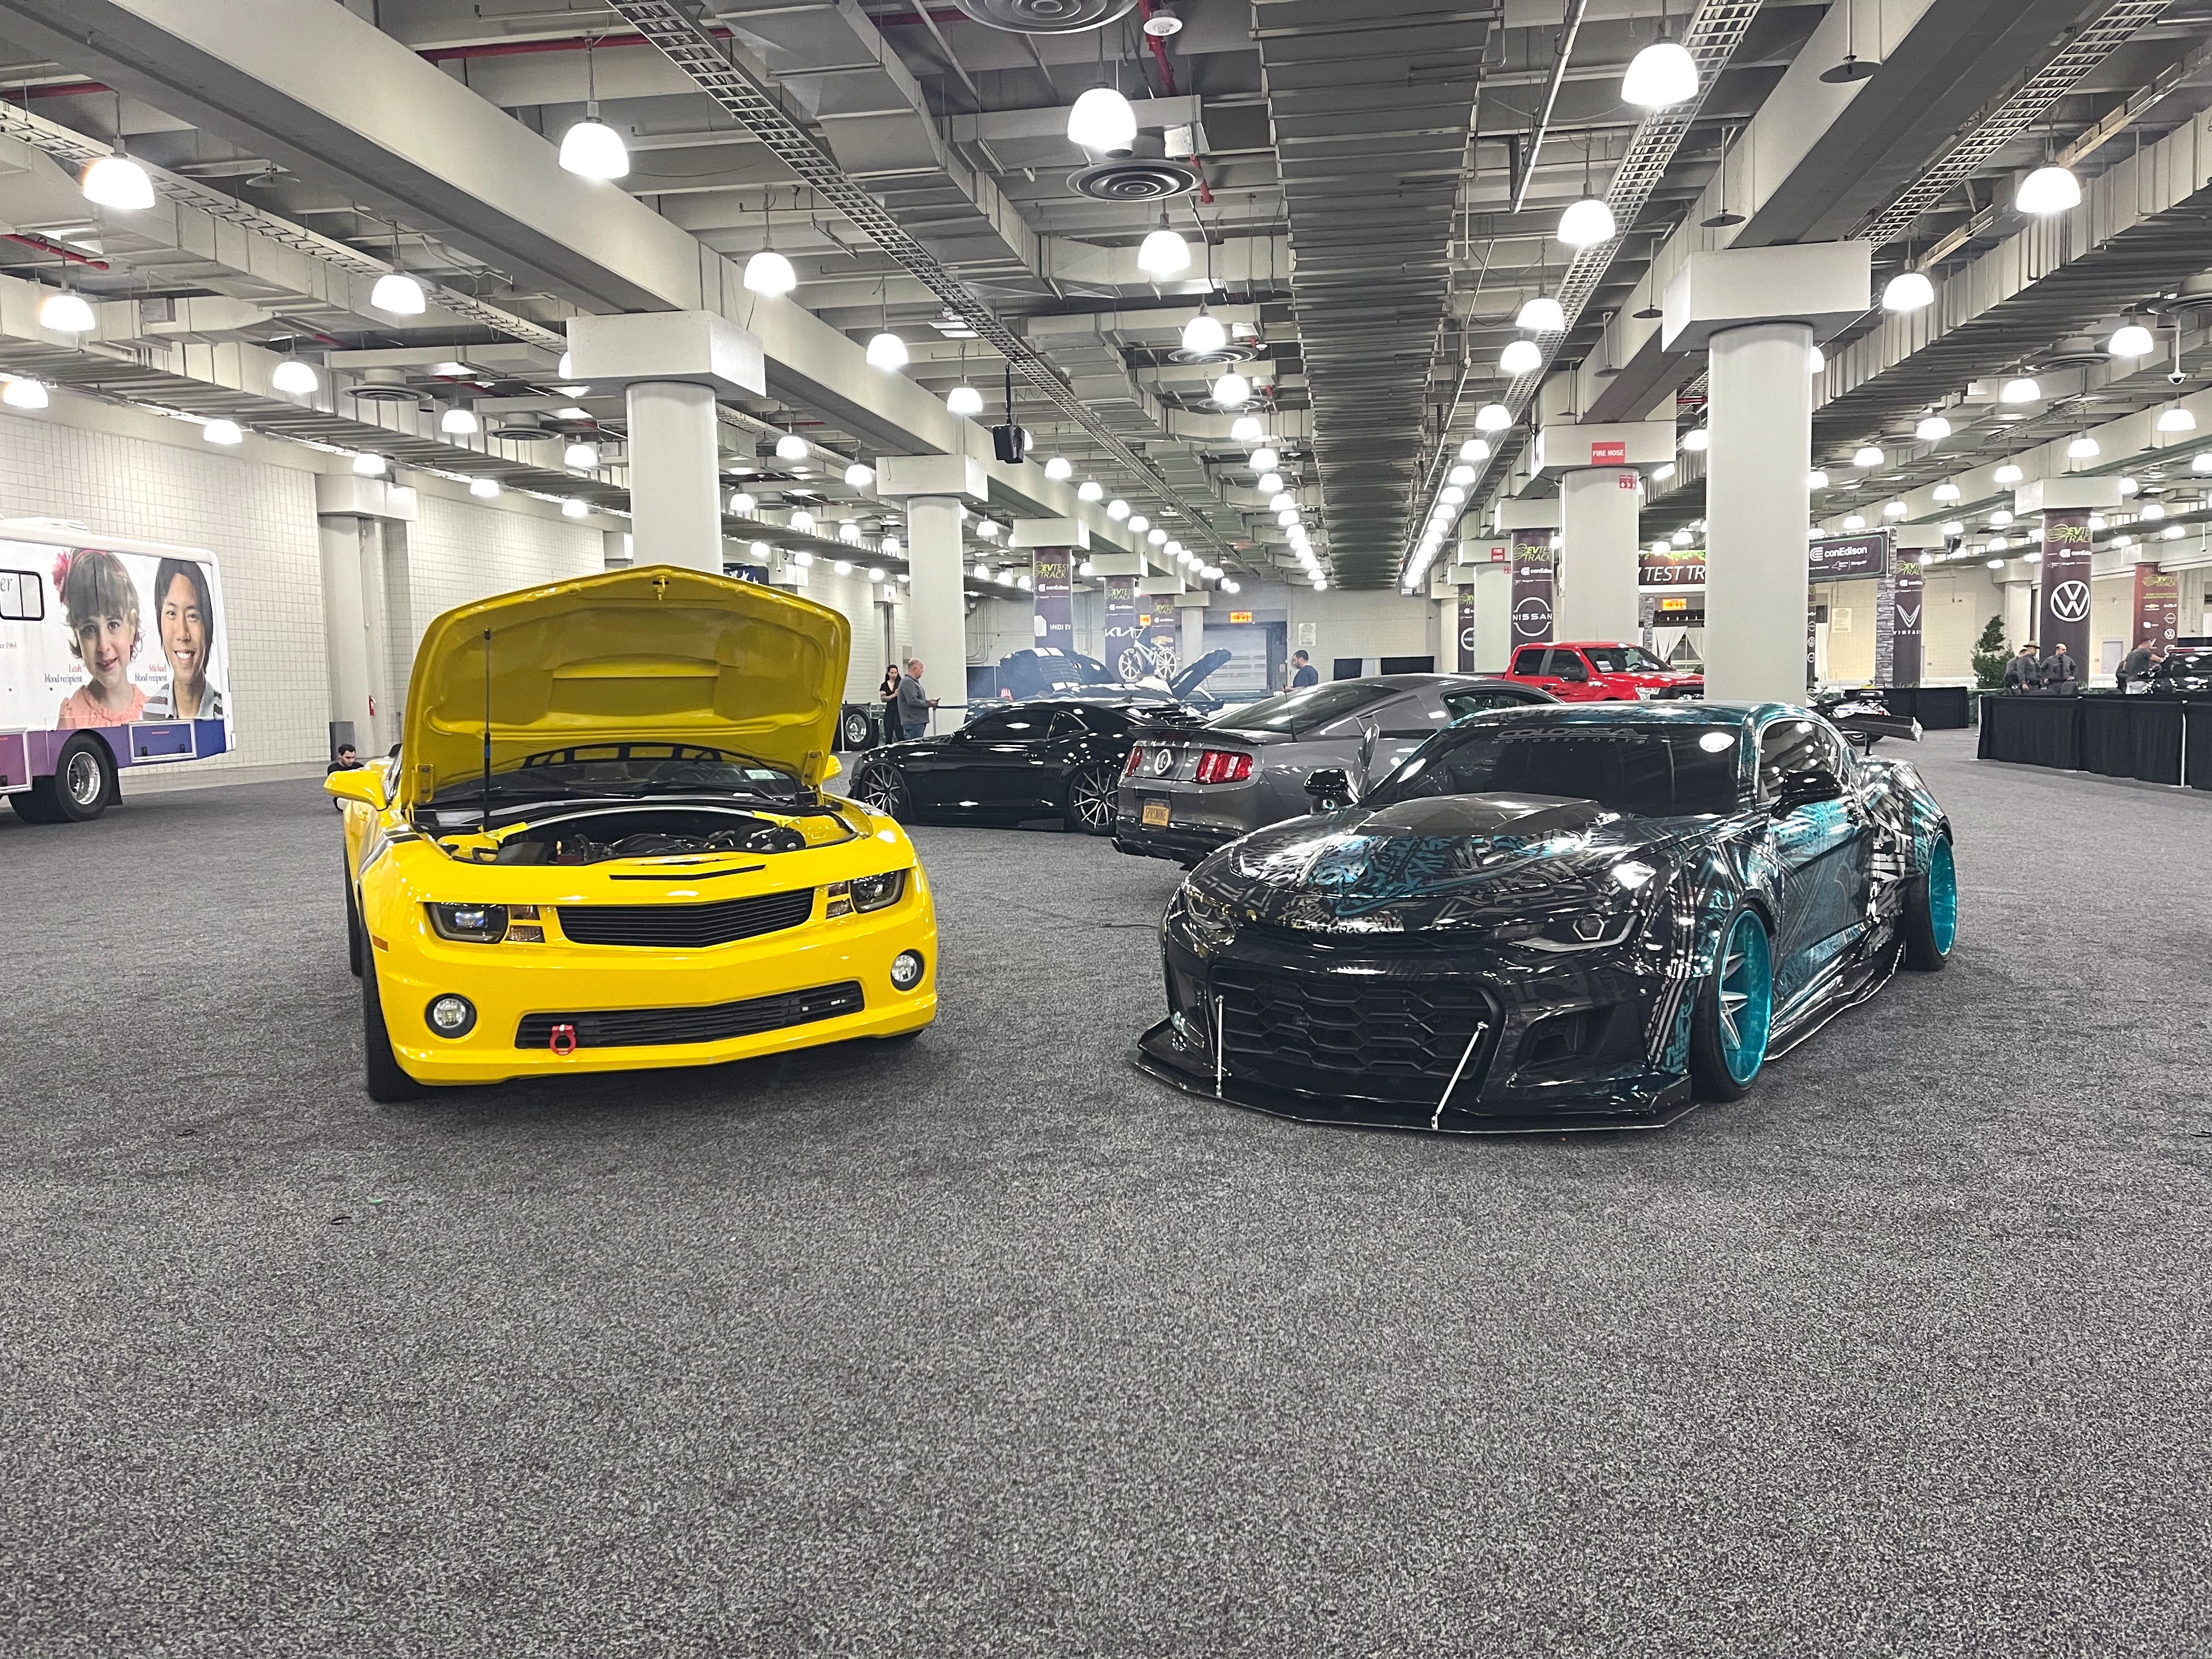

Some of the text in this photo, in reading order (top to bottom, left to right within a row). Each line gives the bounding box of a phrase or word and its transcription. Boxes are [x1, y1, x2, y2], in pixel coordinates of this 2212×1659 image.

[2064, 535, 2091, 543] TRAC
[1824, 546, 1867, 558] conEdison
[1524, 554, 1550, 562] TRACK
[1040, 571, 1066, 579] TRACK
[1645, 566, 1684, 582] TEST
[1513, 613, 1552, 621] NISSAN
[44, 674, 82, 685] blood recipient
[148, 674, 167, 684] recipient
